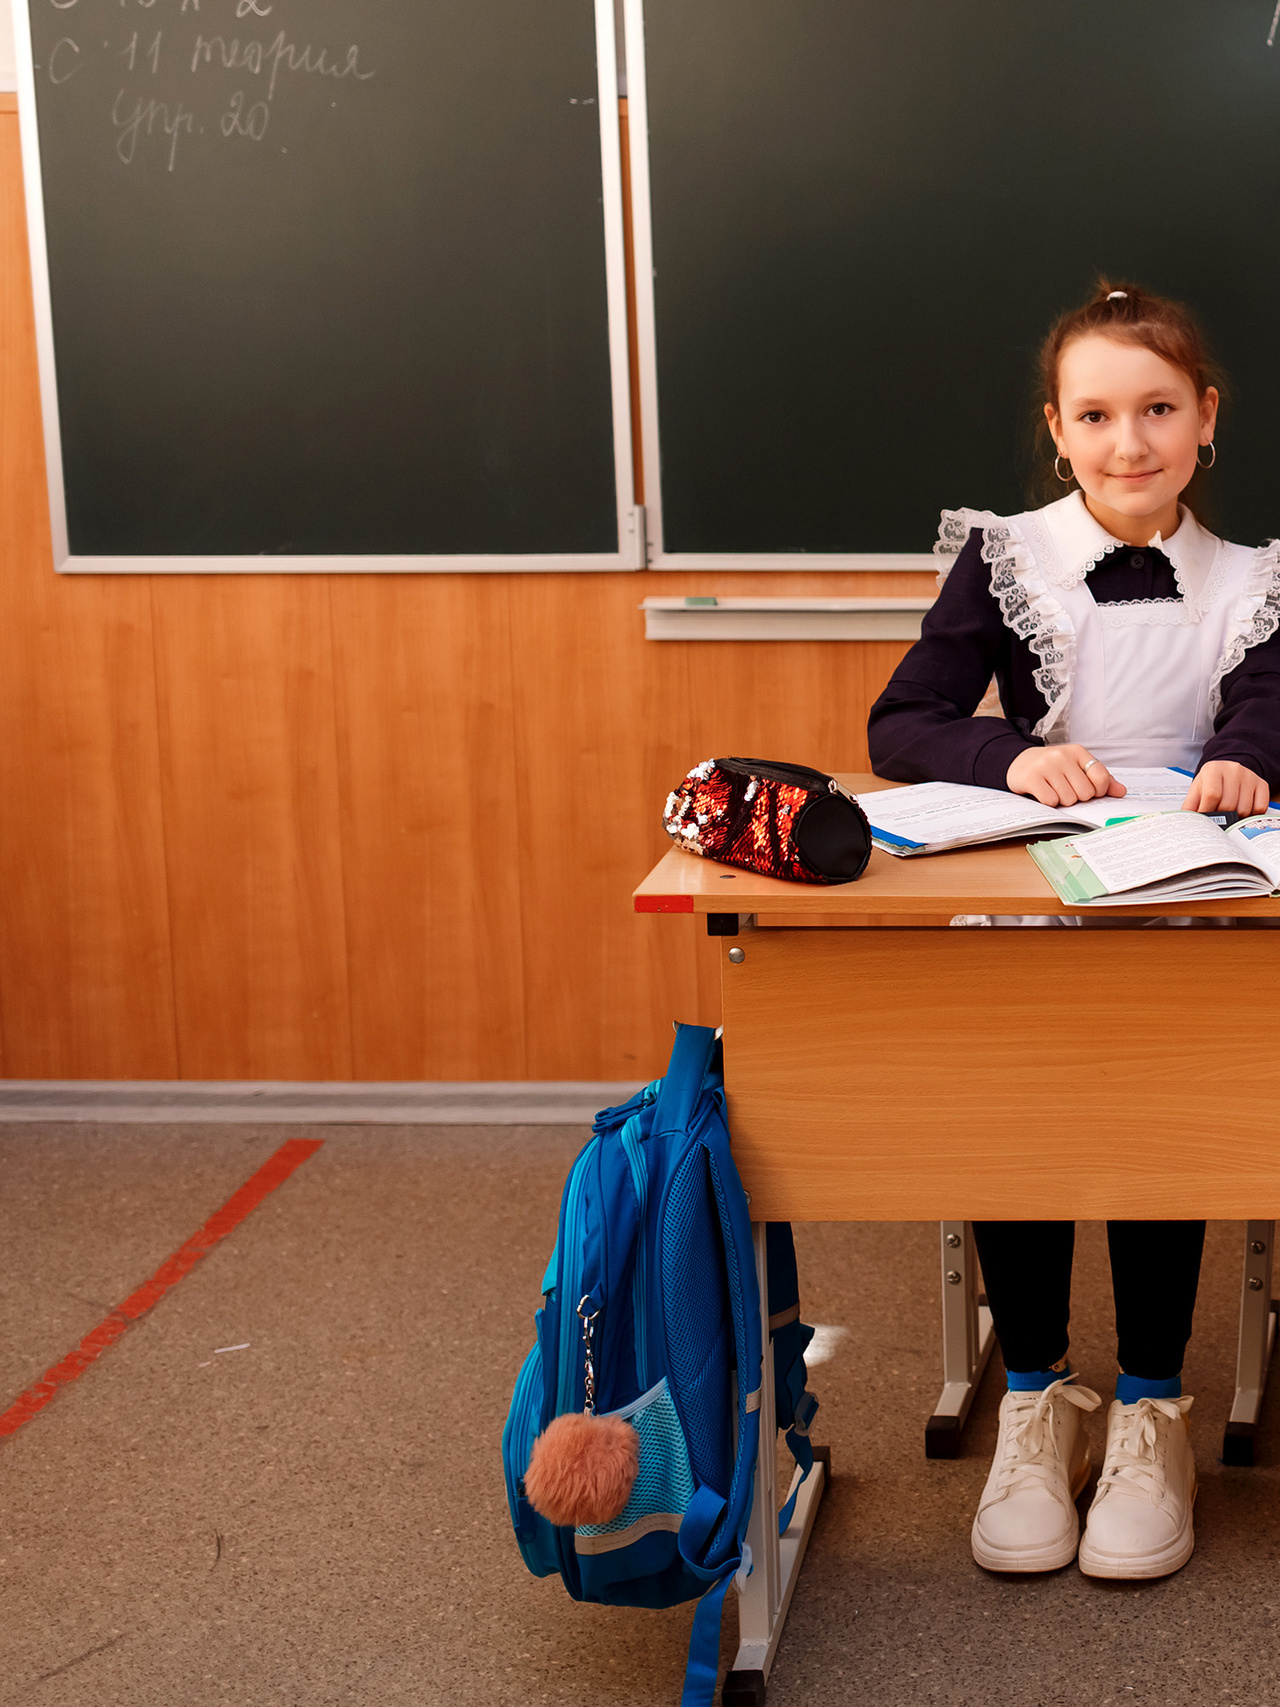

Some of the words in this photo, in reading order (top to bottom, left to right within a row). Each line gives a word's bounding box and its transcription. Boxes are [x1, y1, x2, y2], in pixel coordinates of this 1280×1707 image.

[123, 30, 162, 74] 11
[192, 30, 375, 100] теория
[221, 90, 269, 140] 20
